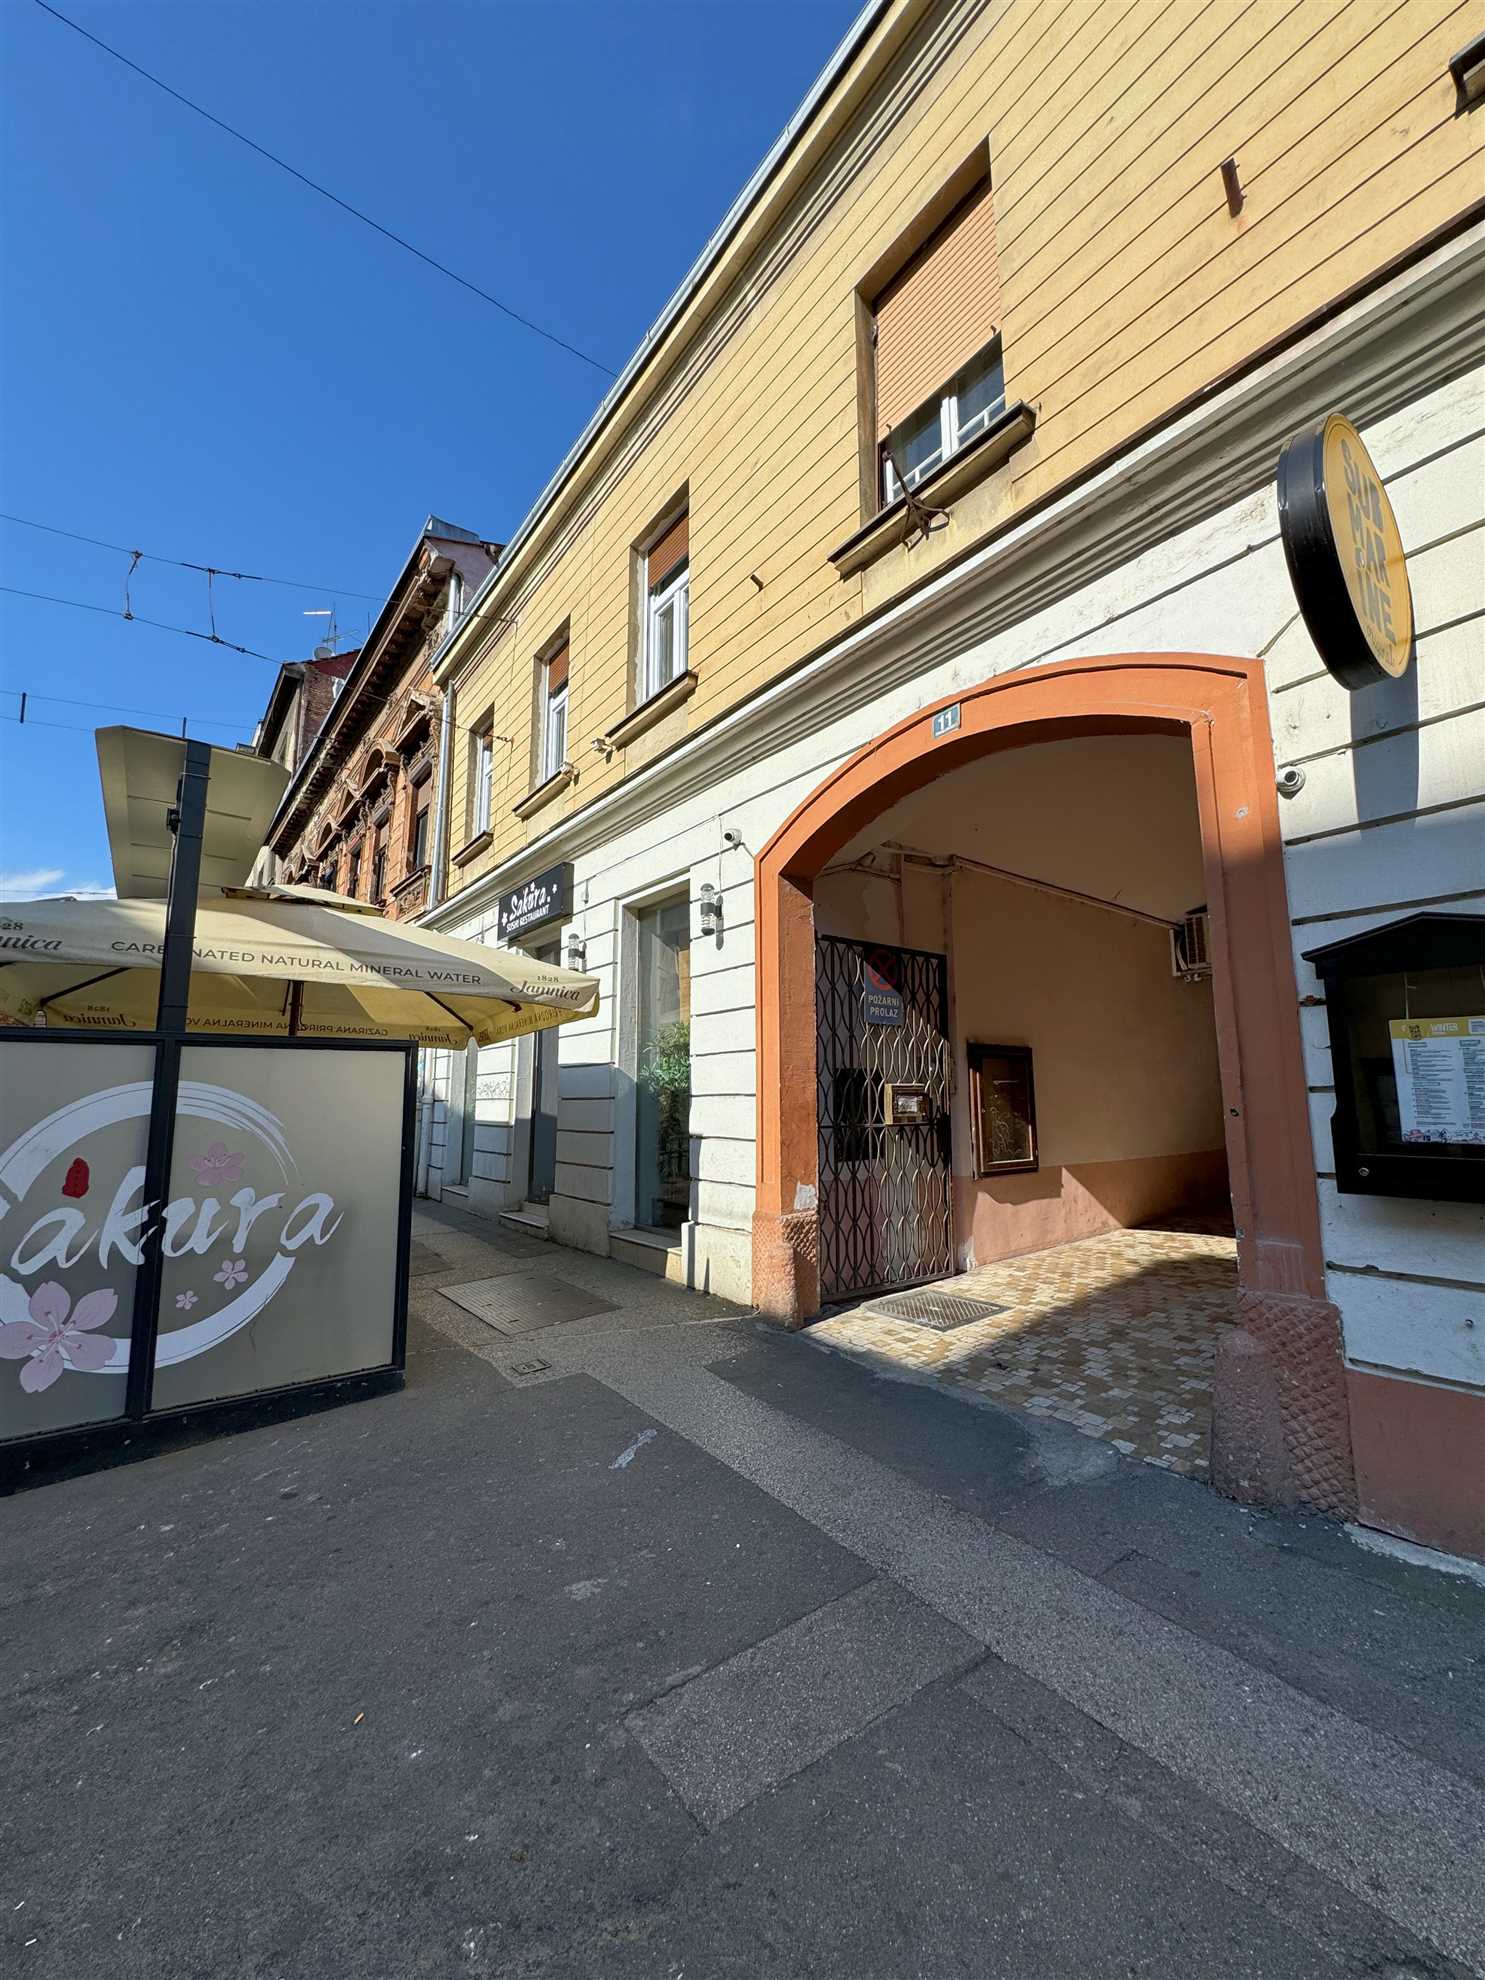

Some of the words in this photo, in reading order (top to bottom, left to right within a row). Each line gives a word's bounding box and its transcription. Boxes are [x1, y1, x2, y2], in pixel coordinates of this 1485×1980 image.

[938, 711, 952, 732] 11
[0, 935, 62, 950] nica
[261, 955, 345, 971] NATURAL
[350, 963, 423, 978] MINERAL
[428, 971, 481, 985] WATER
[868, 993, 900, 1007] POŽARNI
[870, 1006, 899, 1018] PROLAZ
[0, 1166, 345, 1275] akura
